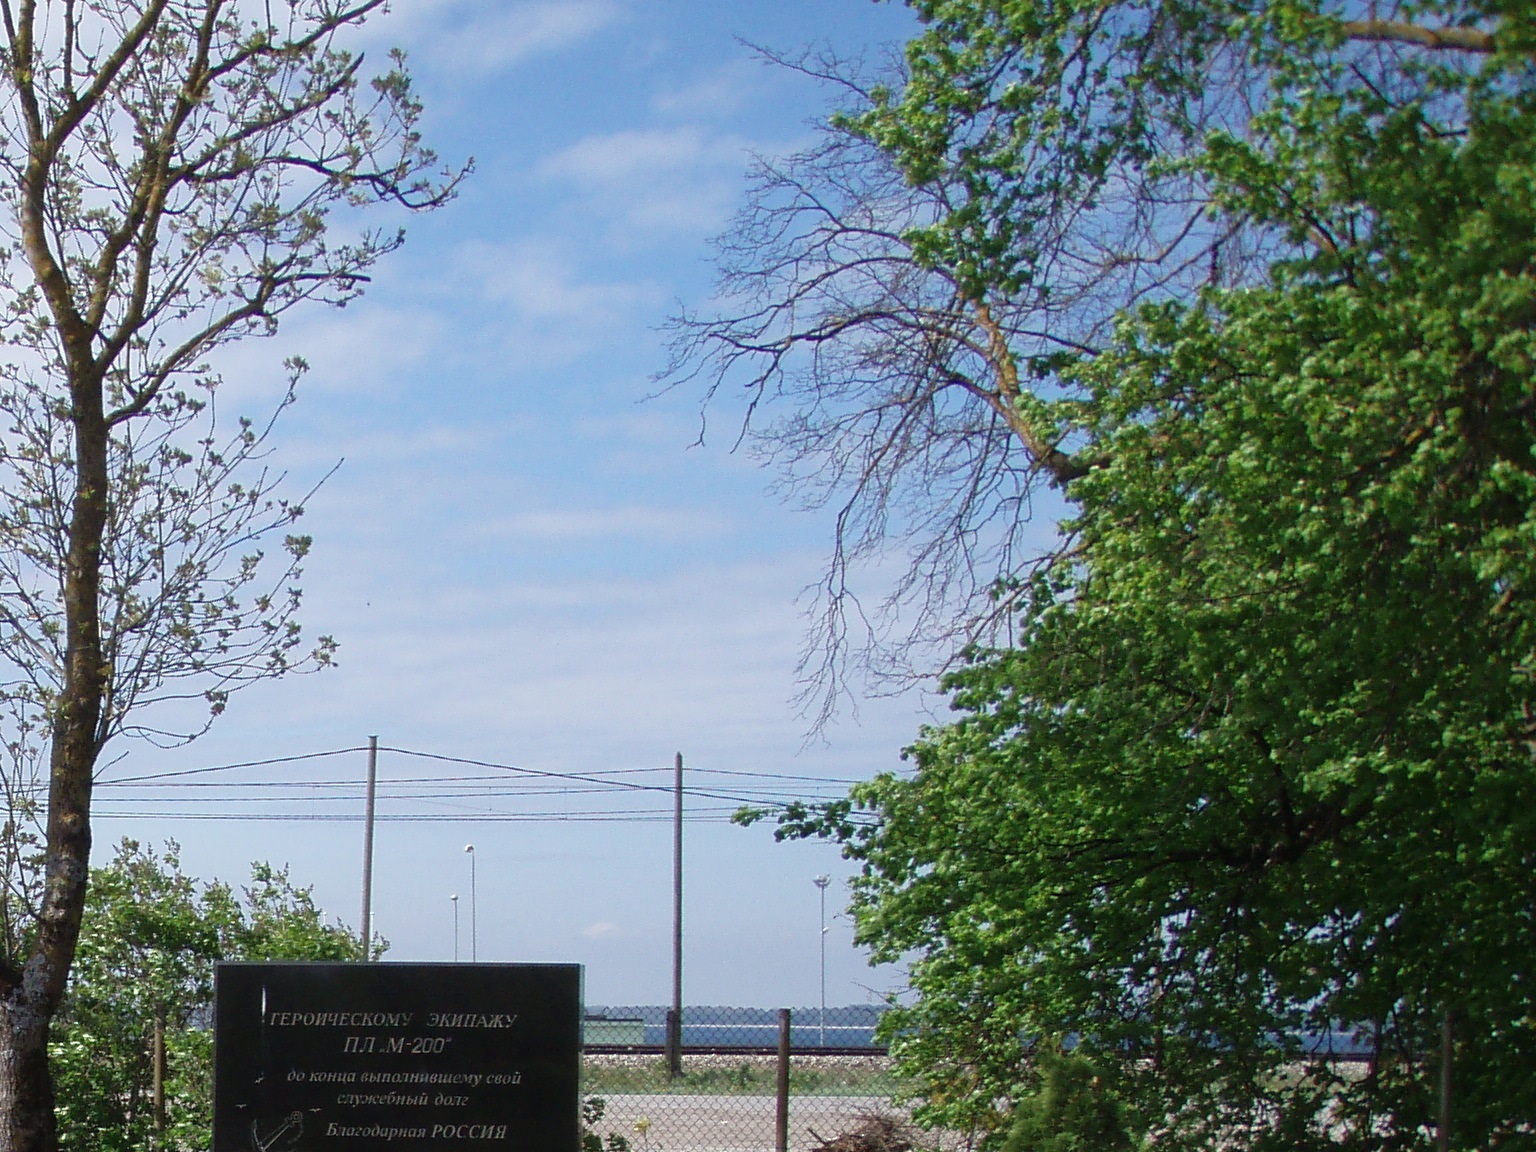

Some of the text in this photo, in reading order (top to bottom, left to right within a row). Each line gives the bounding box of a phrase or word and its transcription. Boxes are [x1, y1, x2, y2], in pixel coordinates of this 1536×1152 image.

[269, 1011, 518, 1029] ГЕРОИЧЕСКОМУ ЭКИПАЖУ
[343, 1036, 375, 1054] ПЛ
[286, 1069, 522, 1087] до конца выполнившему свой
[336, 1091, 469, 1107] служебный долг
[325, 1122, 508, 1141] Благодарная РОССИЯ
